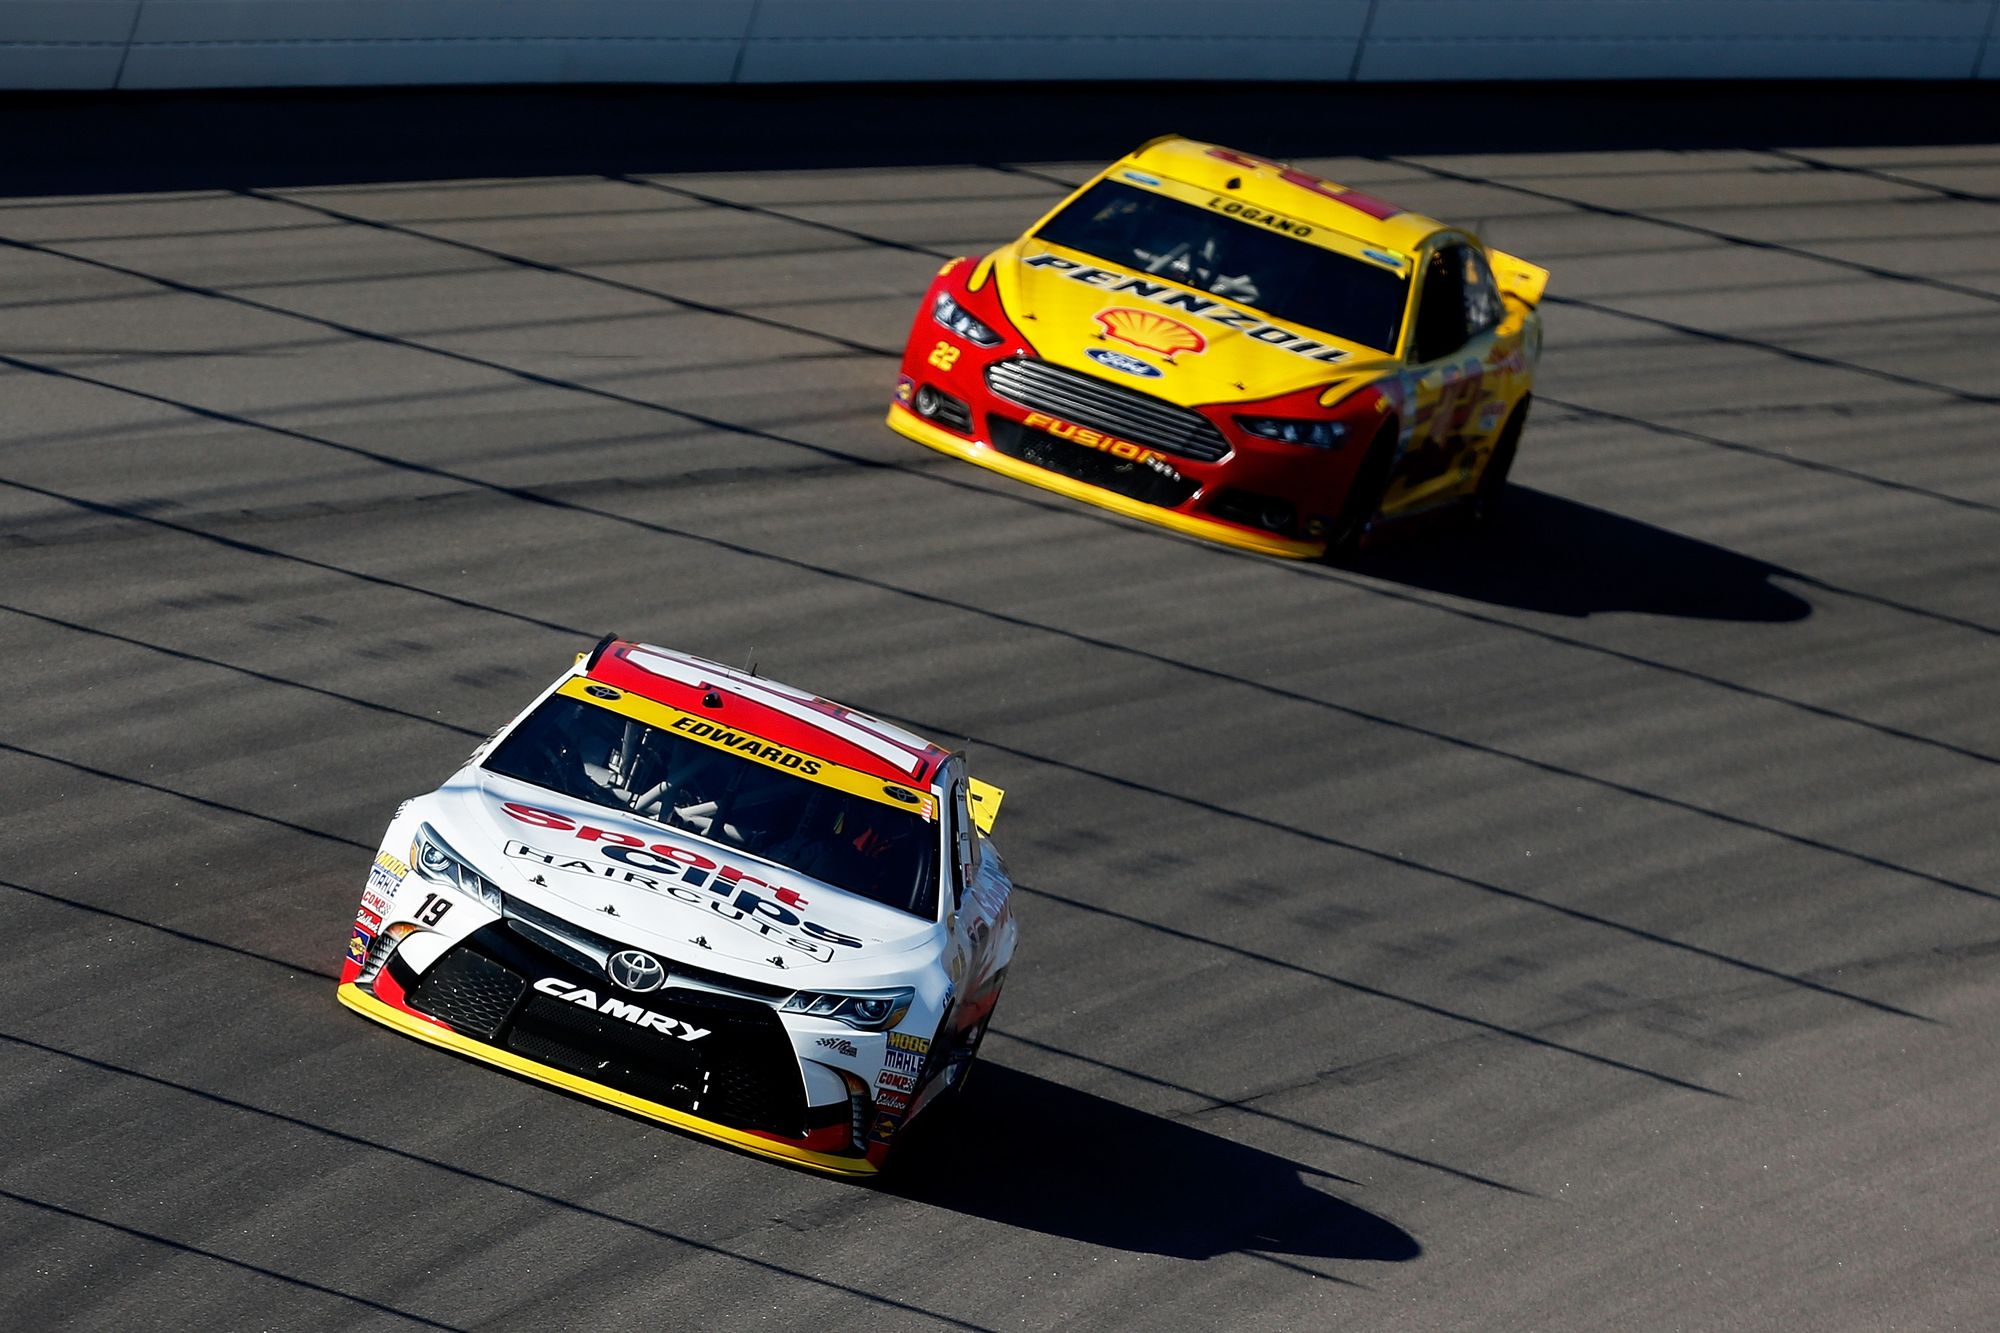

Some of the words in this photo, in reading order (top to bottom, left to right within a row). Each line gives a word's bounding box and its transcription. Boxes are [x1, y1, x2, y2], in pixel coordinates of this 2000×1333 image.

[1207, 196, 1314, 238] LOGANO
[1023, 252, 1354, 365] PENNZOIL
[928, 340, 961, 372] 22
[670, 716, 822, 776] EDWARDS
[375, 850, 409, 878] MOOG
[500, 801, 809, 912] Sport
[362, 890, 386, 911] COMP
[369, 868, 400, 898] MAHLE
[518, 845, 819, 953] HAIRCUTS
[601, 844, 863, 949] Clips
[414, 892, 454, 927] 19
[533, 977, 712, 1041] CAMRY
[889, 1032, 930, 1053] MOOG
[884, 1049, 926, 1074] MAHLE
[879, 1073, 907, 1089] COMP
